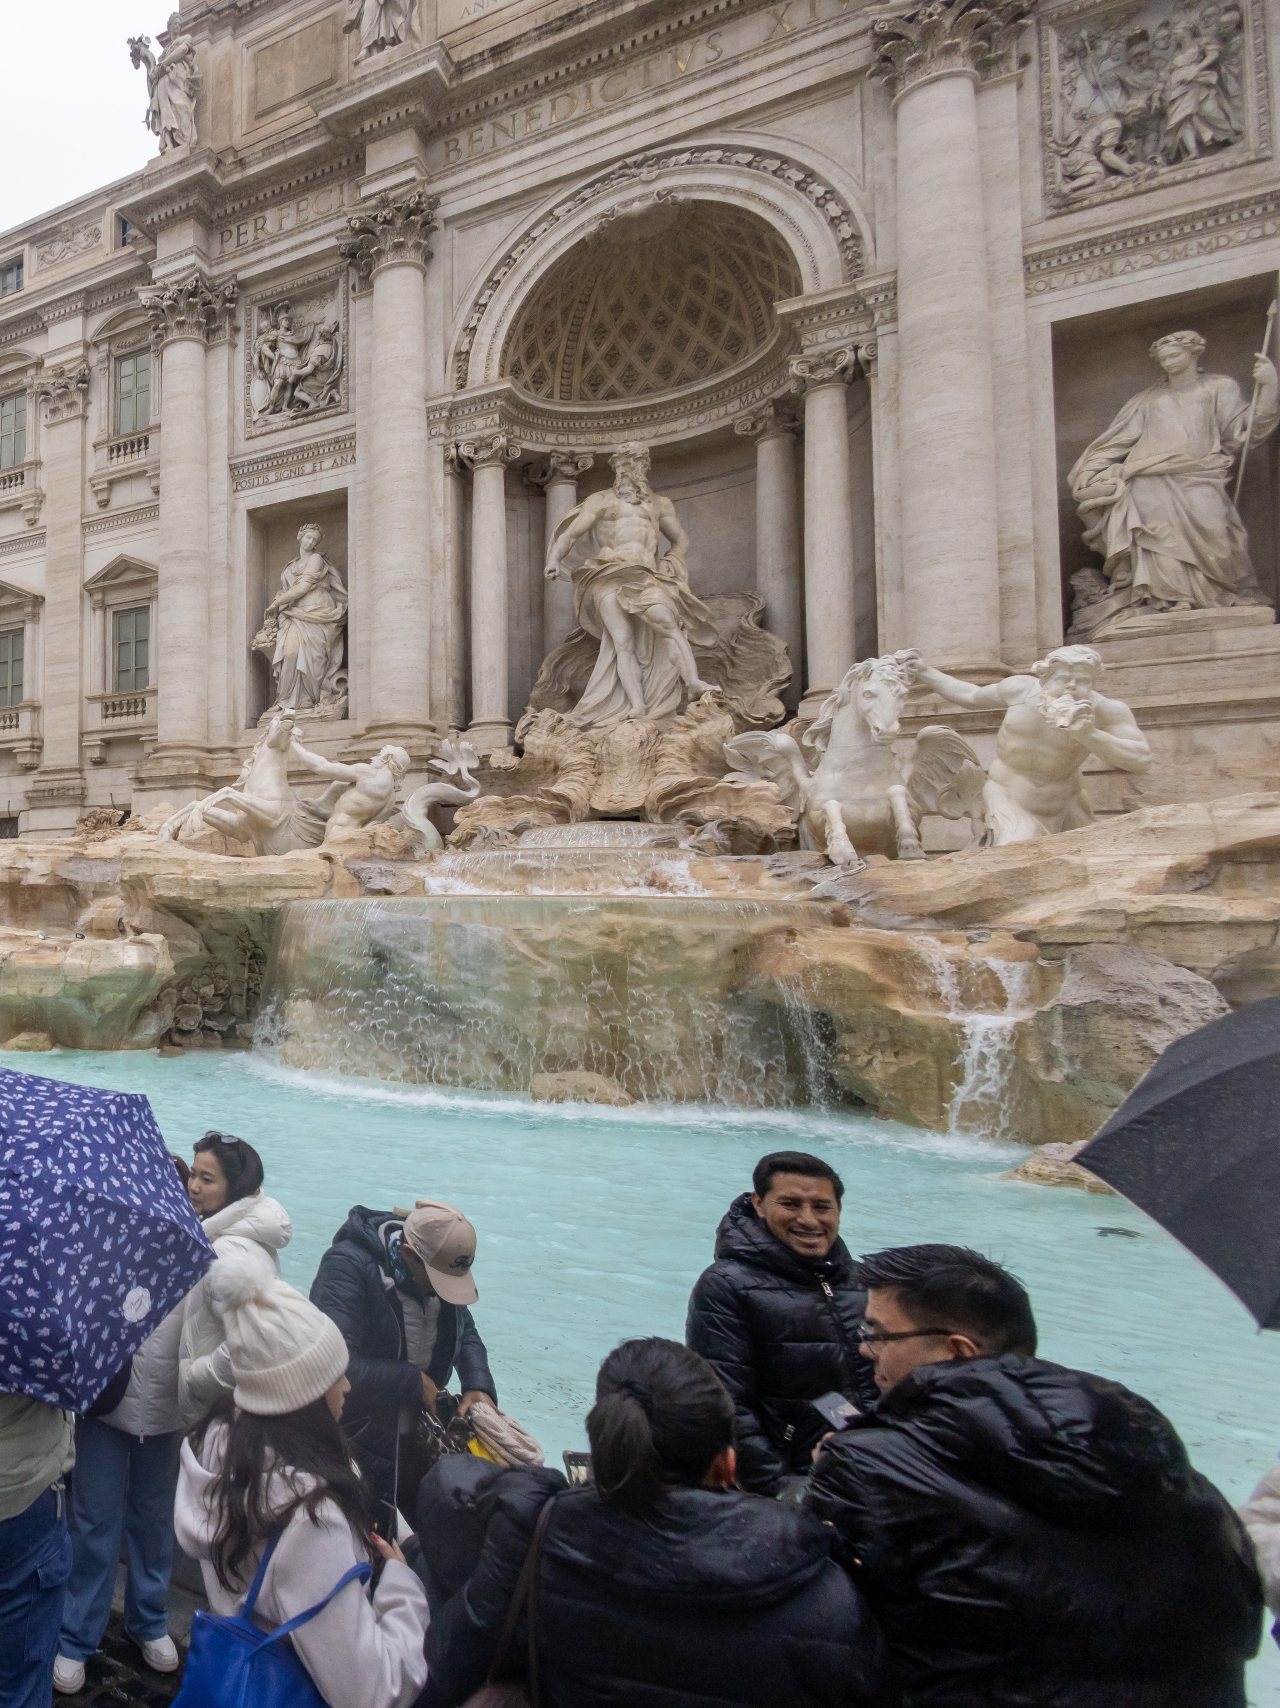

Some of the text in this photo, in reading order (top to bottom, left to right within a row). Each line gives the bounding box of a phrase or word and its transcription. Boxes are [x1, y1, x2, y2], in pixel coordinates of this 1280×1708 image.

[460, 0, 523, 20] AN
[443, 0, 849, 168] BENEDICTVS XI
[235, 474, 270, 491] POSITIS
[275, 465, 305, 481] SIGNIS
[313, 460, 325, 472] ET
